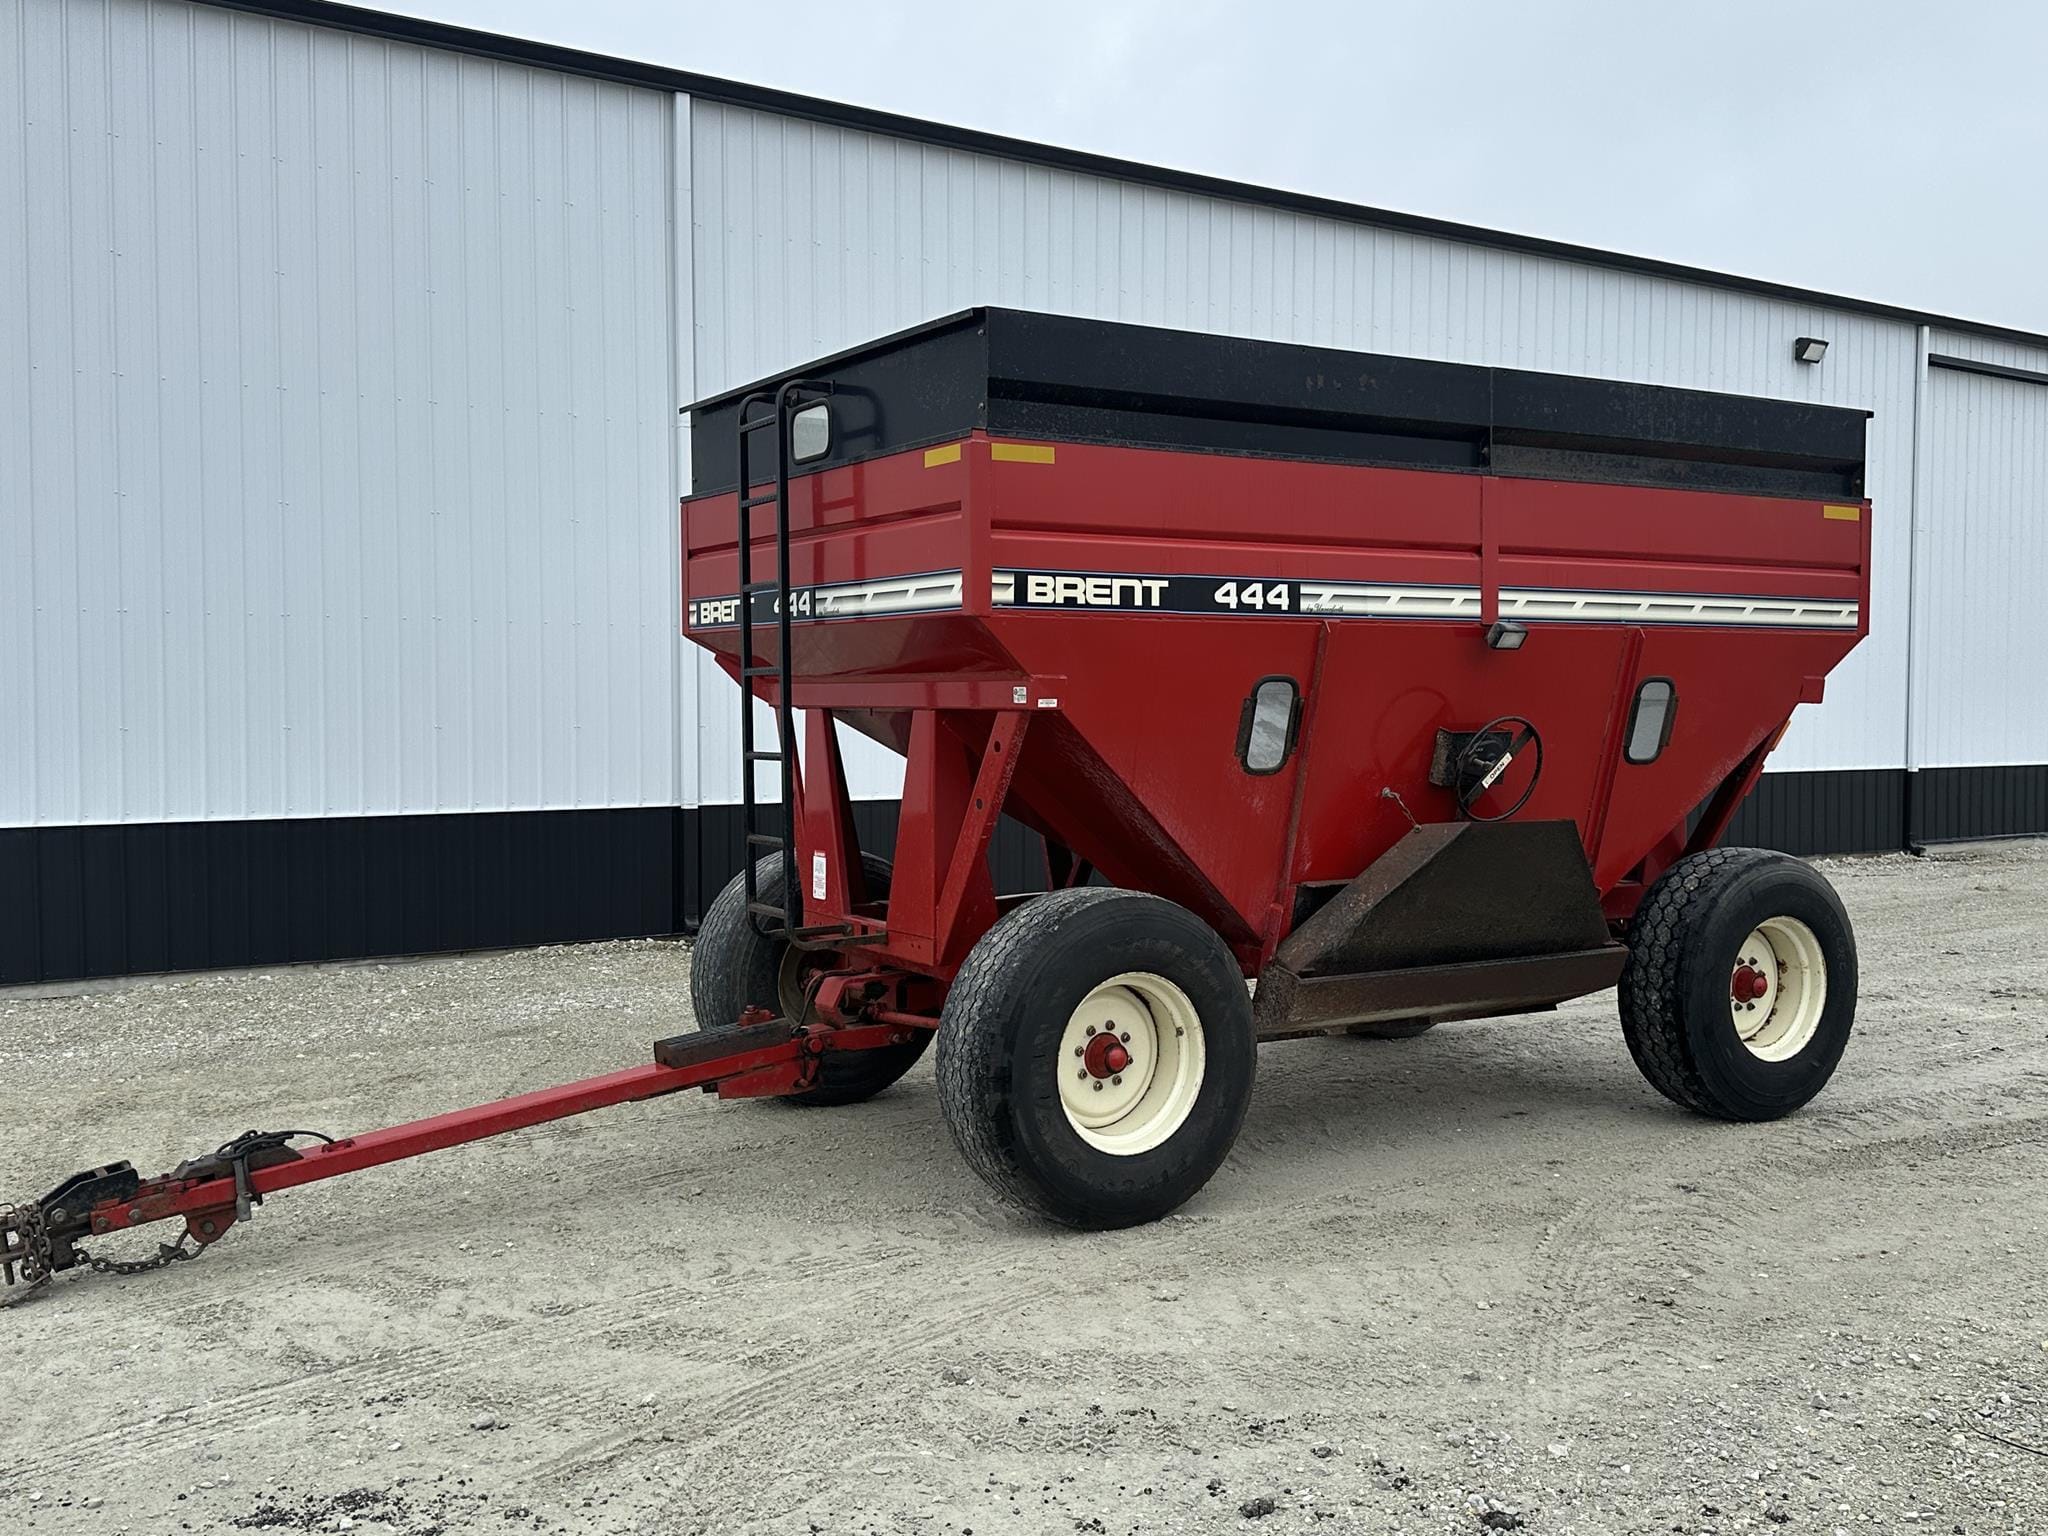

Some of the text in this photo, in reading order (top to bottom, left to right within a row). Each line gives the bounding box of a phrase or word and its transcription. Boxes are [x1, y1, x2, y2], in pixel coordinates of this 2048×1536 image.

[1027, 574, 1290, 611] BRENT 444
[1489, 761, 1505, 779] OPEN
